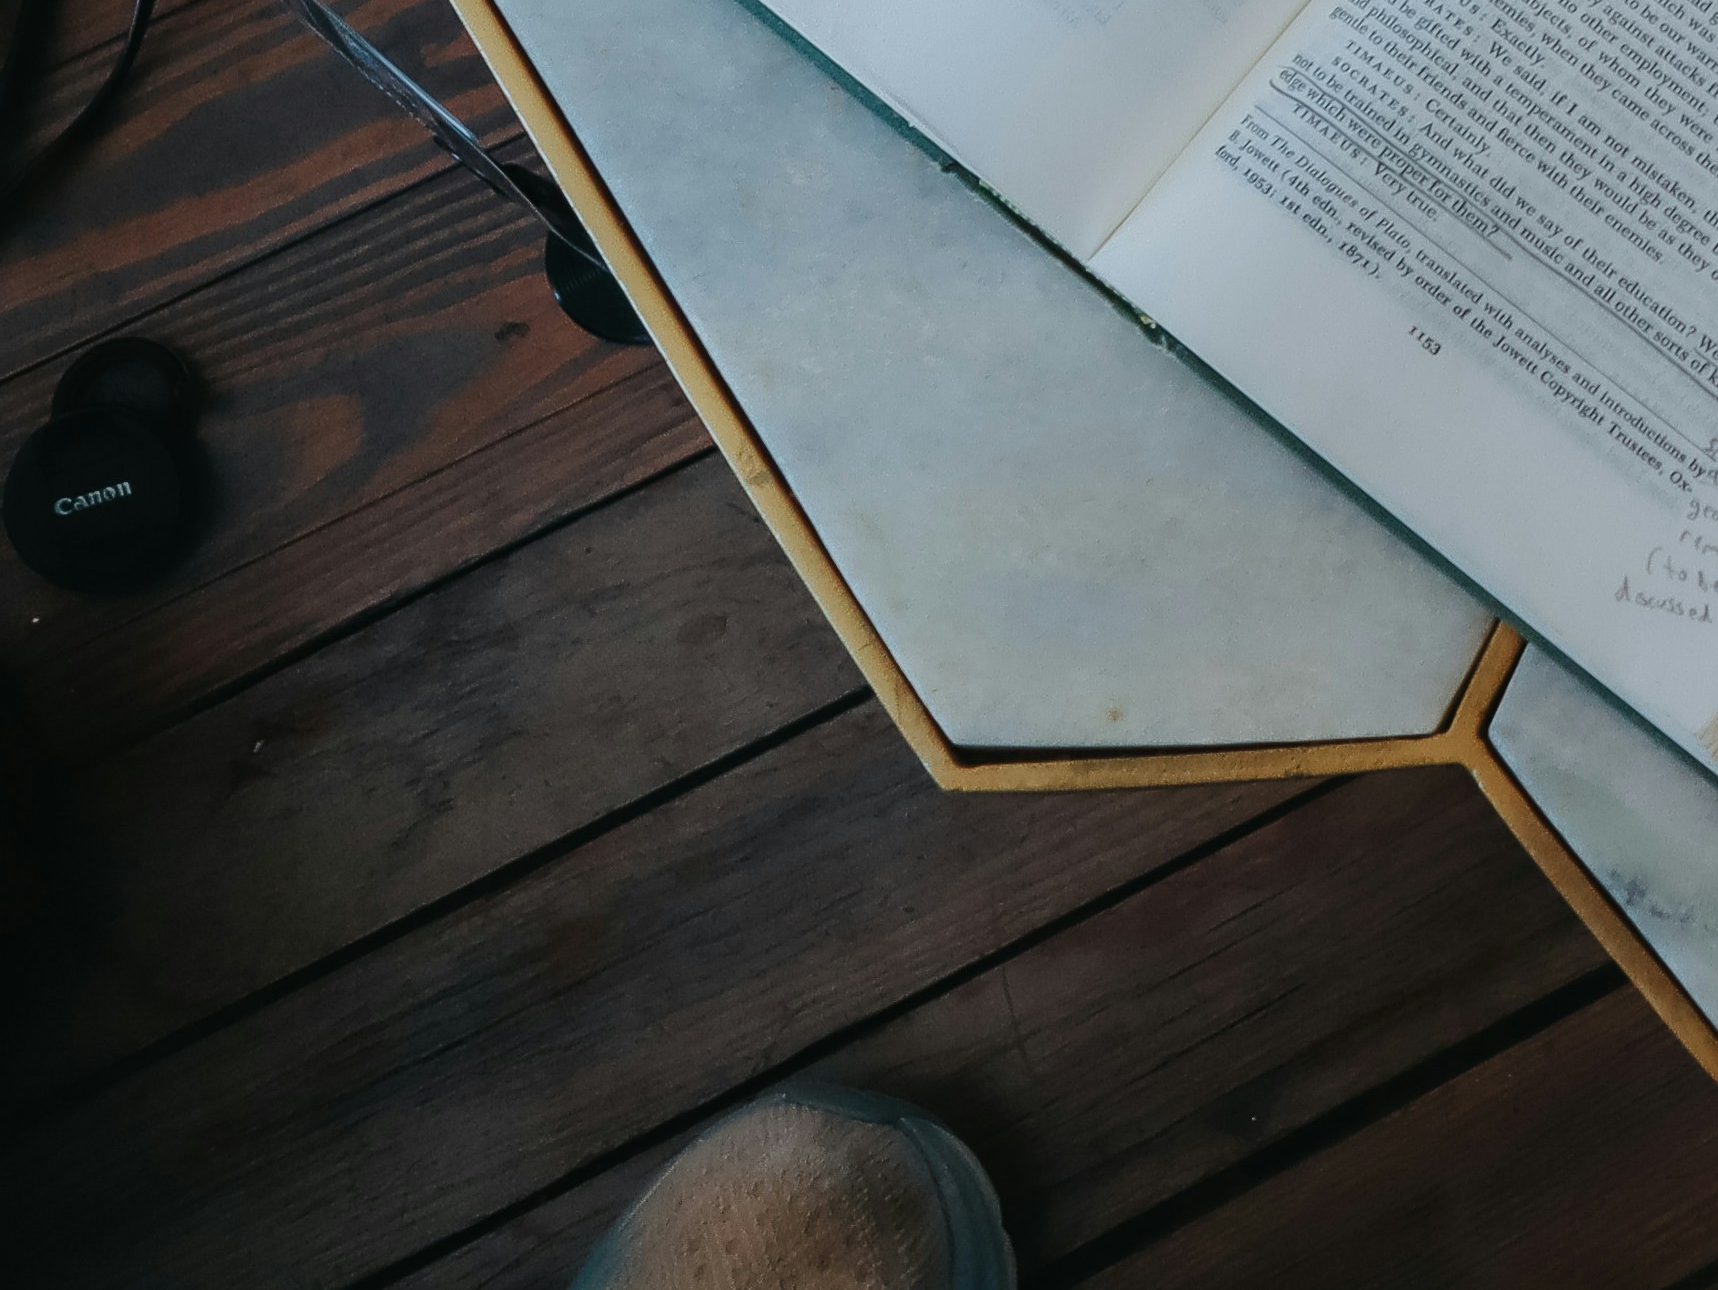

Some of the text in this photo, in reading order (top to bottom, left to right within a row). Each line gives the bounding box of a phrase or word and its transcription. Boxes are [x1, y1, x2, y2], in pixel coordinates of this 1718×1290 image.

[1215, 145, 1380, 279] ford, 1953; 1st edn., 1871).
[1238, 139, 1280, 173] Jowett
[1281, 169, 1310, 197] (4th
[1312, 196, 1342, 226] edn.,
[1345, 222, 1397, 262] revised
[1395, 256, 1414, 278] by
[1414, 275, 1452, 306] order
[1452, 305, 1472, 320] of
[1470, 317, 1493, 339] the
[1492, 334, 1538, 375] Jowett
[1540, 370, 1605, 426] Copyright
[1608, 421, 1663, 475] Trustees,
[1669, 470, 1693, 493] Ox-
[1240, 114, 1707, 479] From The Dialogues of Plato, translated with analyses and introductions by
[1409, 326, 1442, 356] 1153
[54, 480, 132, 516] Canon
